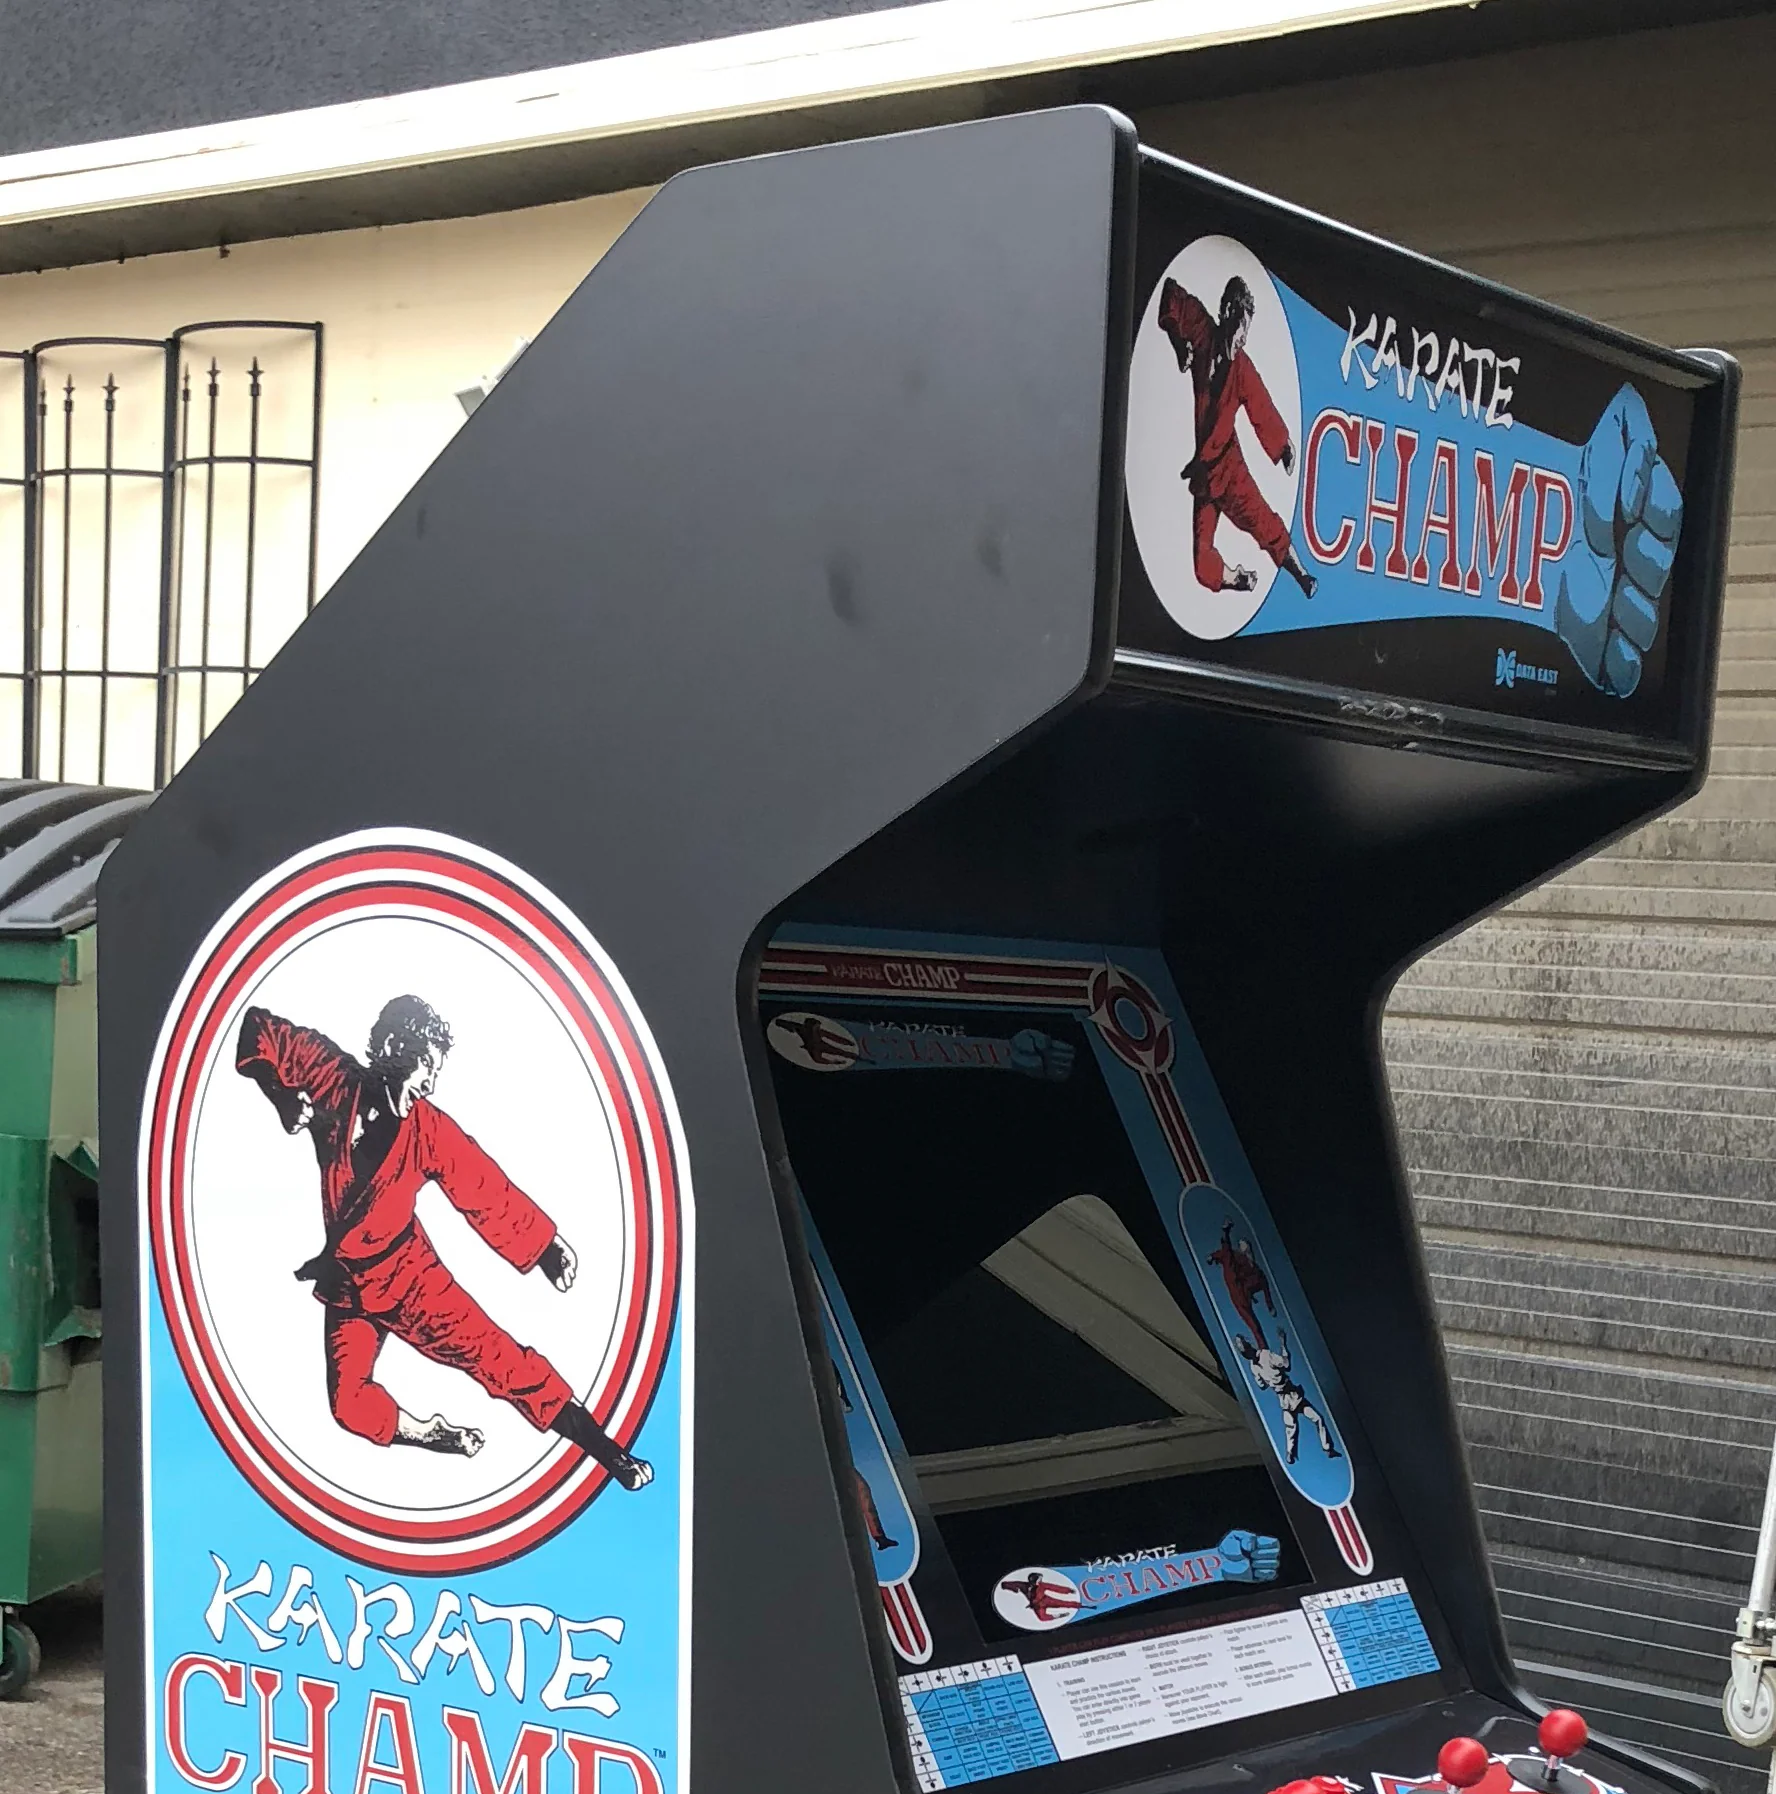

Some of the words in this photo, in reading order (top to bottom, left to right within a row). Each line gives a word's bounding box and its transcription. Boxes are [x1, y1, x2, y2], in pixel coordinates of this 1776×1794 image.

[1340, 306, 1521, 429] KARATE
[1302, 407, 1574, 610] CHAMP
[1515, 663, 1536, 681] DATA
[1536, 667, 1559, 685] EAST
[883, 962, 961, 990] CHAMP
[1079, 1555, 1222, 1603] CHAMP
[1081, 1543, 1178, 1573] KARATE
[204, 1550, 626, 1718] KARATE
